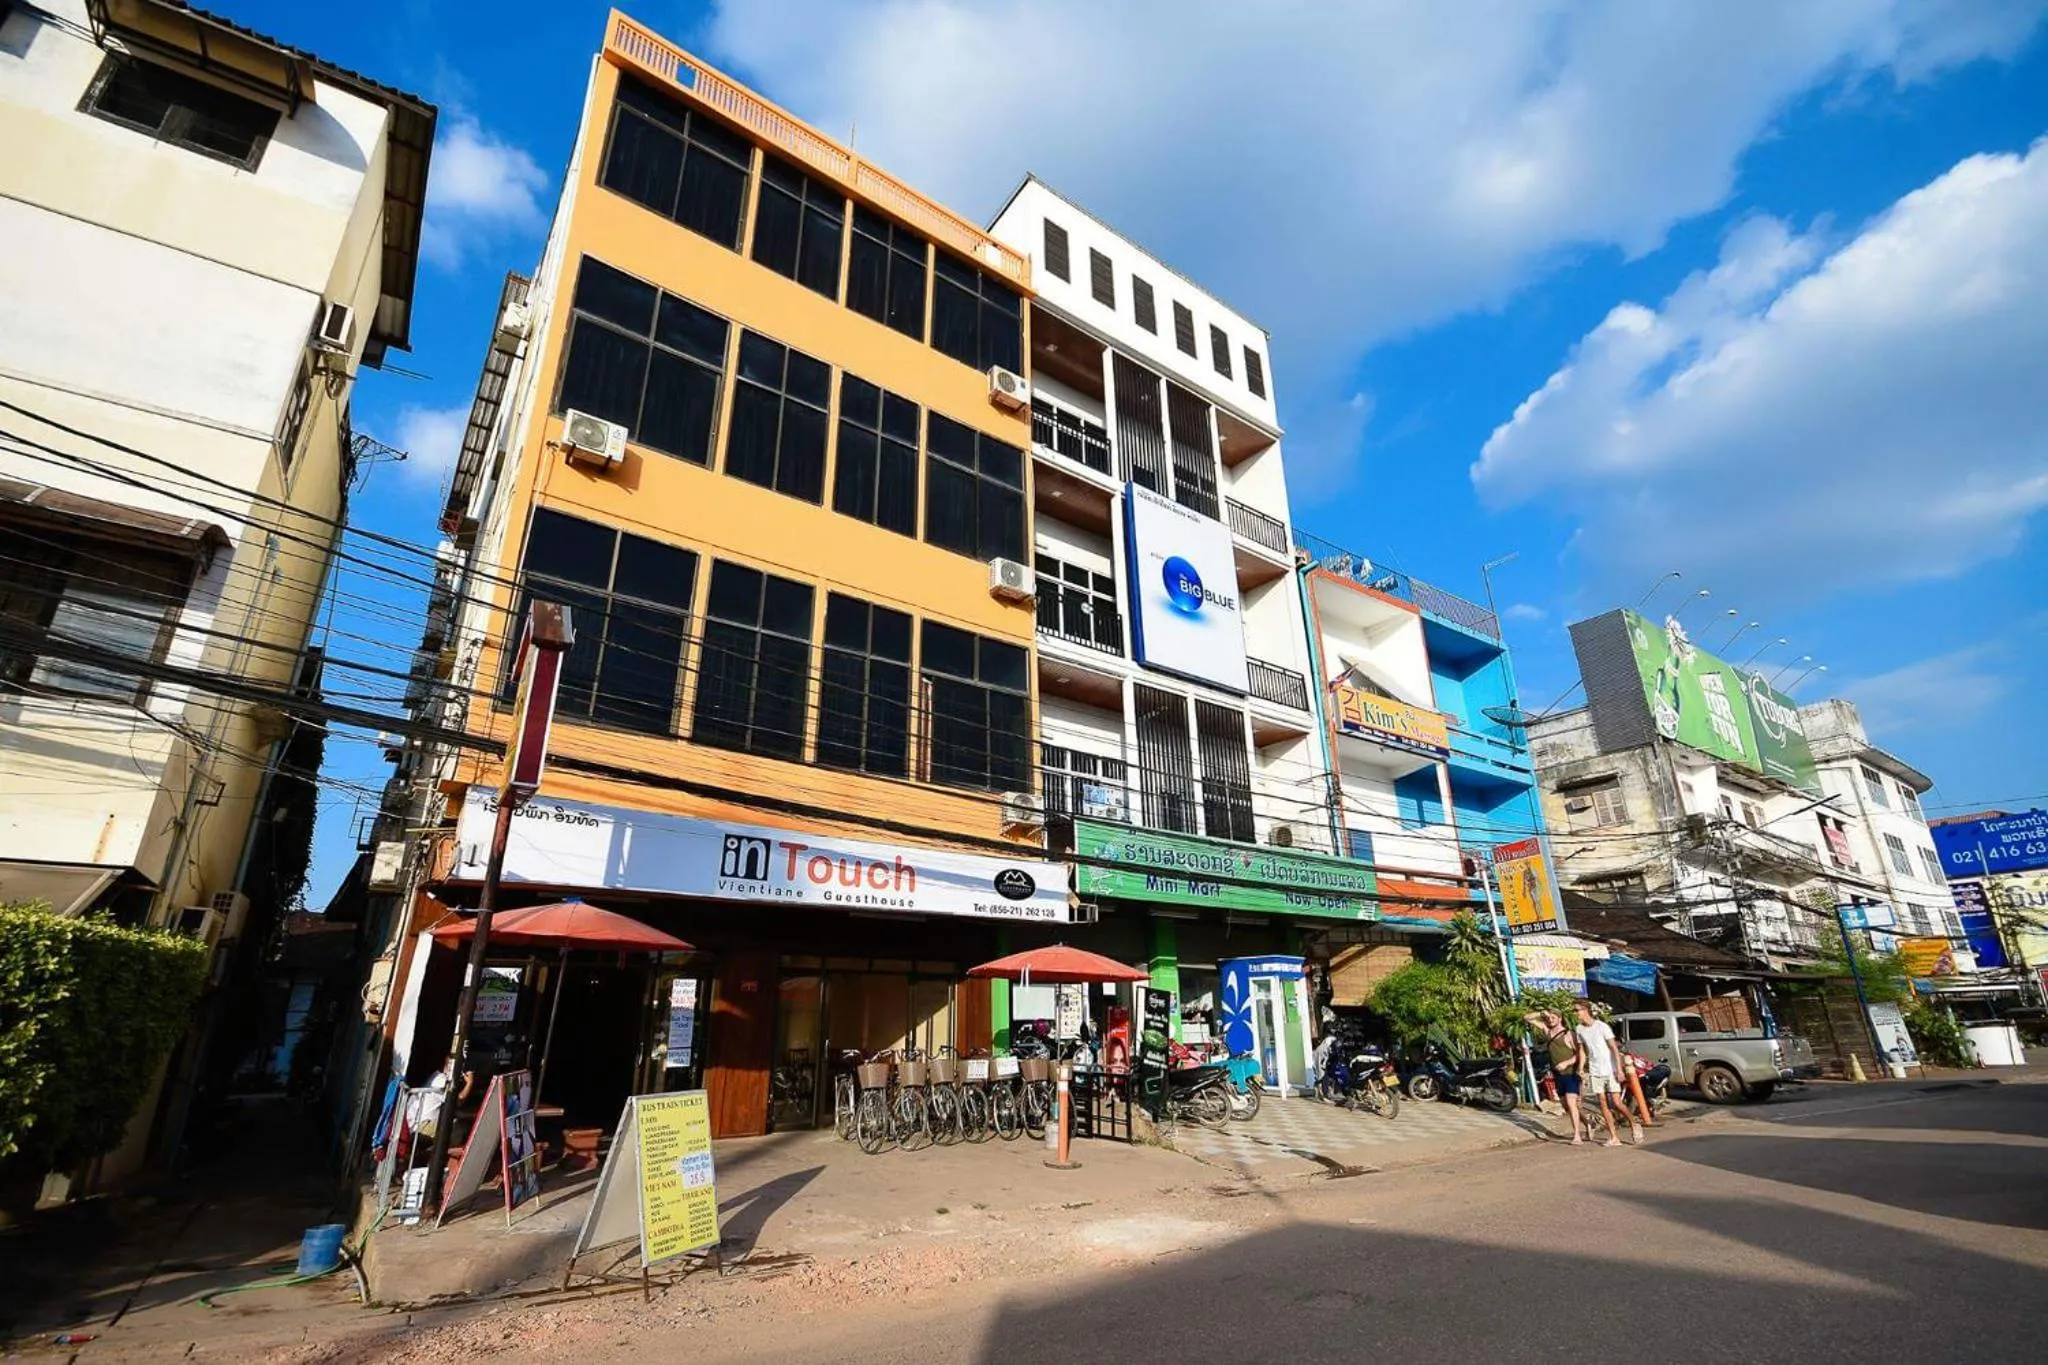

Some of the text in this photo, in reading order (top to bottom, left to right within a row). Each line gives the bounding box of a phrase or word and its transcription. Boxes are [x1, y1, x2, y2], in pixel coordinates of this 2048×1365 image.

[1179, 579, 1236, 611] BIG BLUE
[1363, 702, 1409, 733] Kim's
[724, 837, 916, 893] in Touch
[1952, 849, 1981, 864] 021
[1989, 845, 2020, 859] 416
[718, 880, 915, 908] Vientiane Guesthouse
[1146, 874, 1221, 897] Mini Mart
[973, 903, 988, 913] Tel:
[1285, 892, 1349, 911] Now Open
[641, 1102, 656, 1112] BUS
[679, 1097, 703, 1108] TICKET
